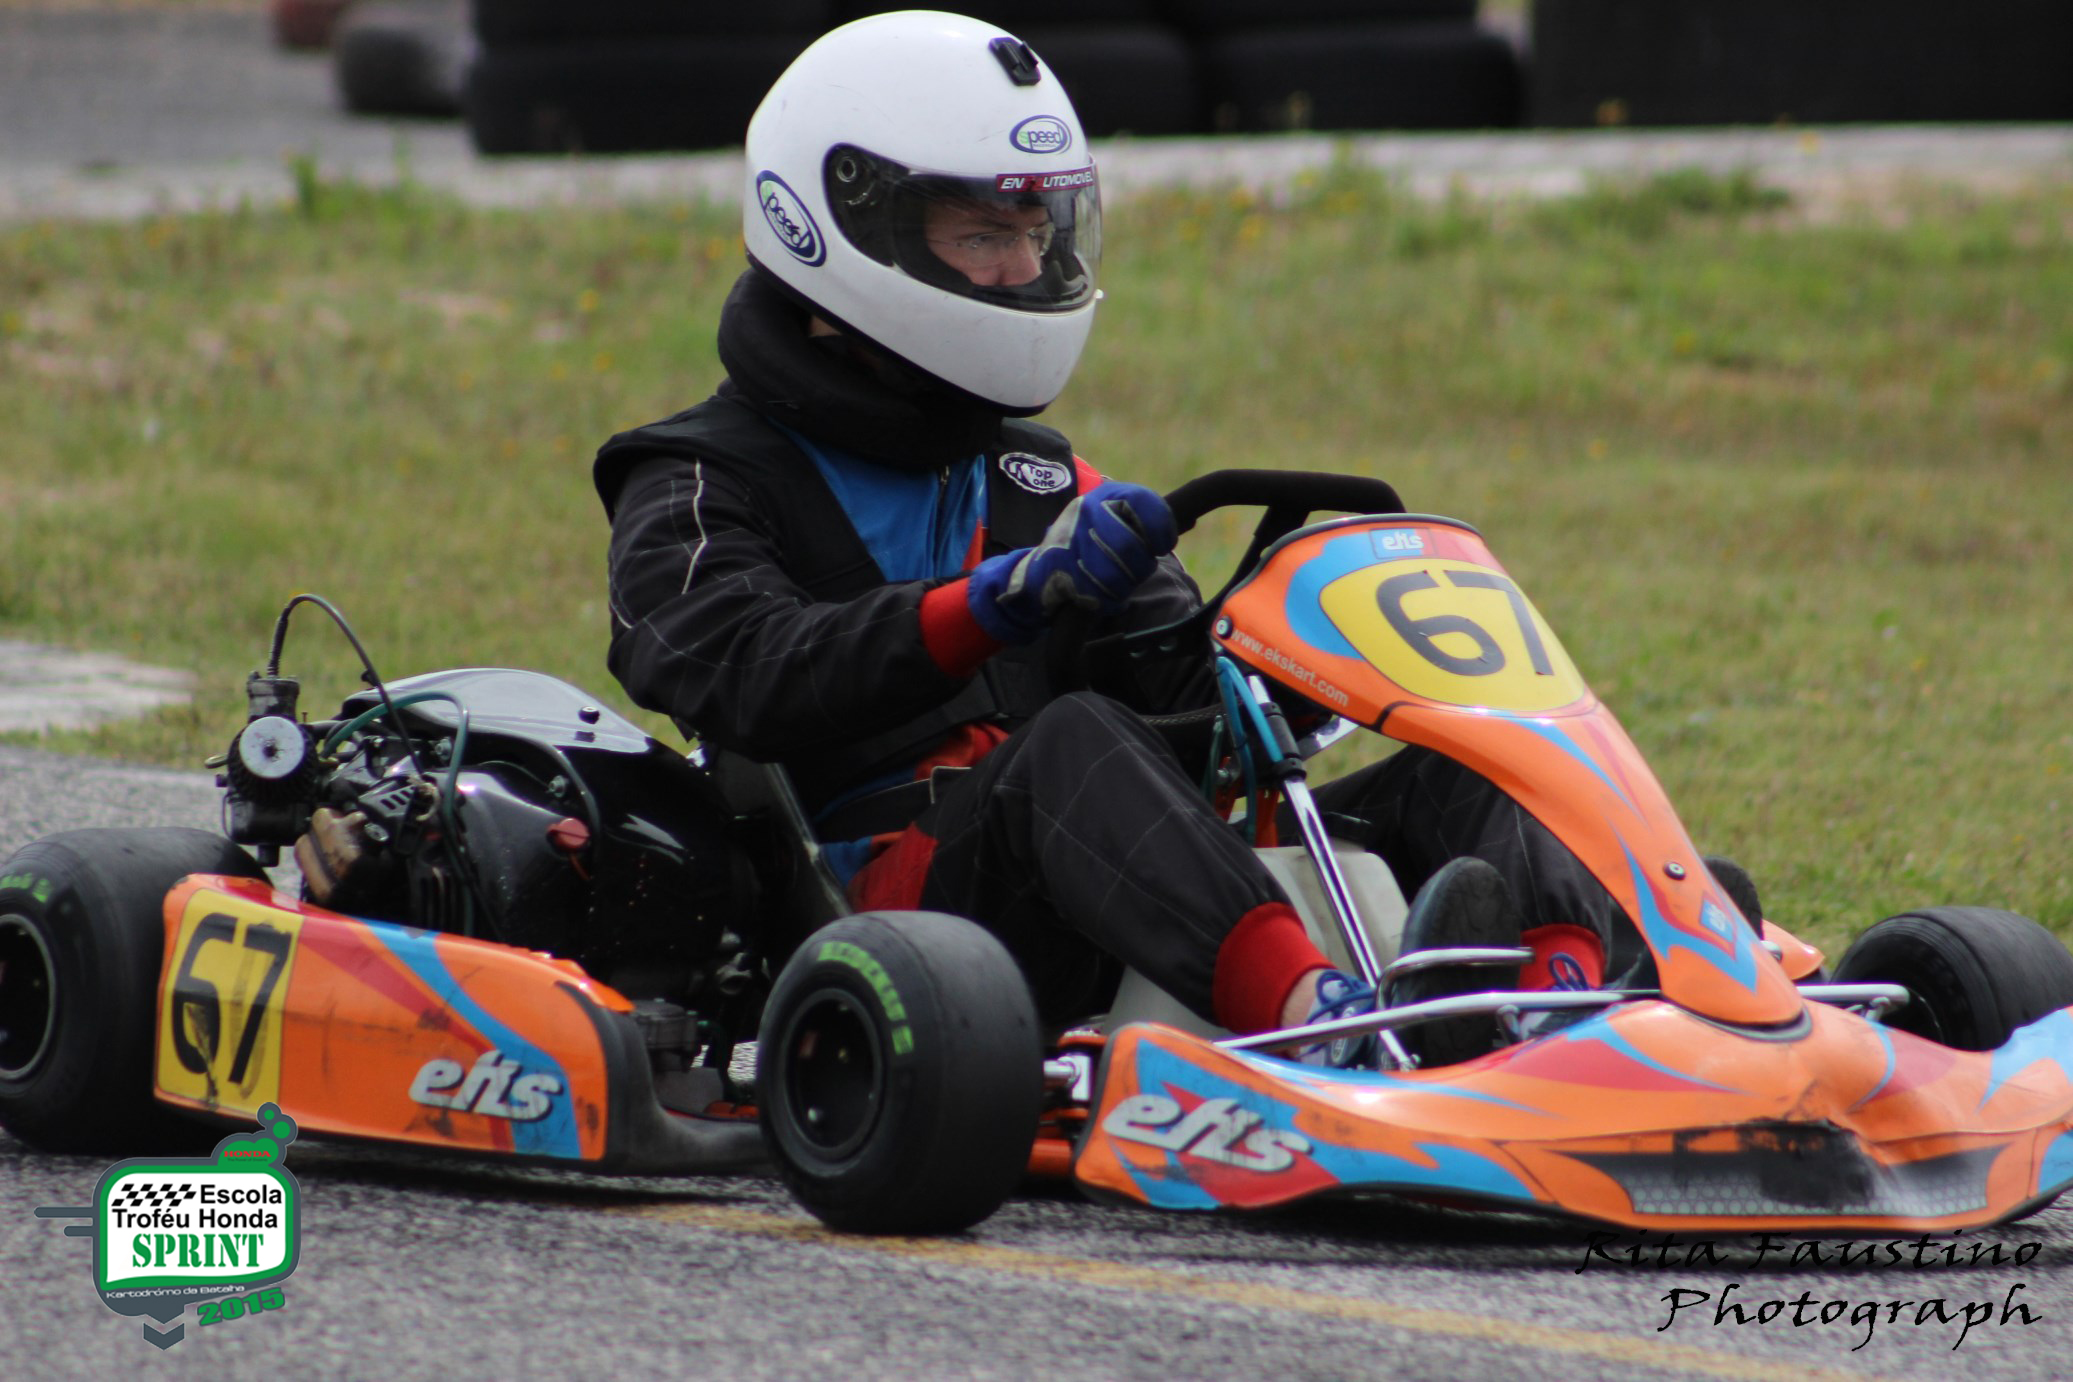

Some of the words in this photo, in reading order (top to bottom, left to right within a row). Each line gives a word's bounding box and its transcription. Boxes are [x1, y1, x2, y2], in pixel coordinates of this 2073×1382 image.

[1019, 122, 1061, 150] speed
[1231, 628, 1350, 708] www.ekskart.com
[1376, 569, 1555, 677] 67
[171, 911, 293, 1086] 67
